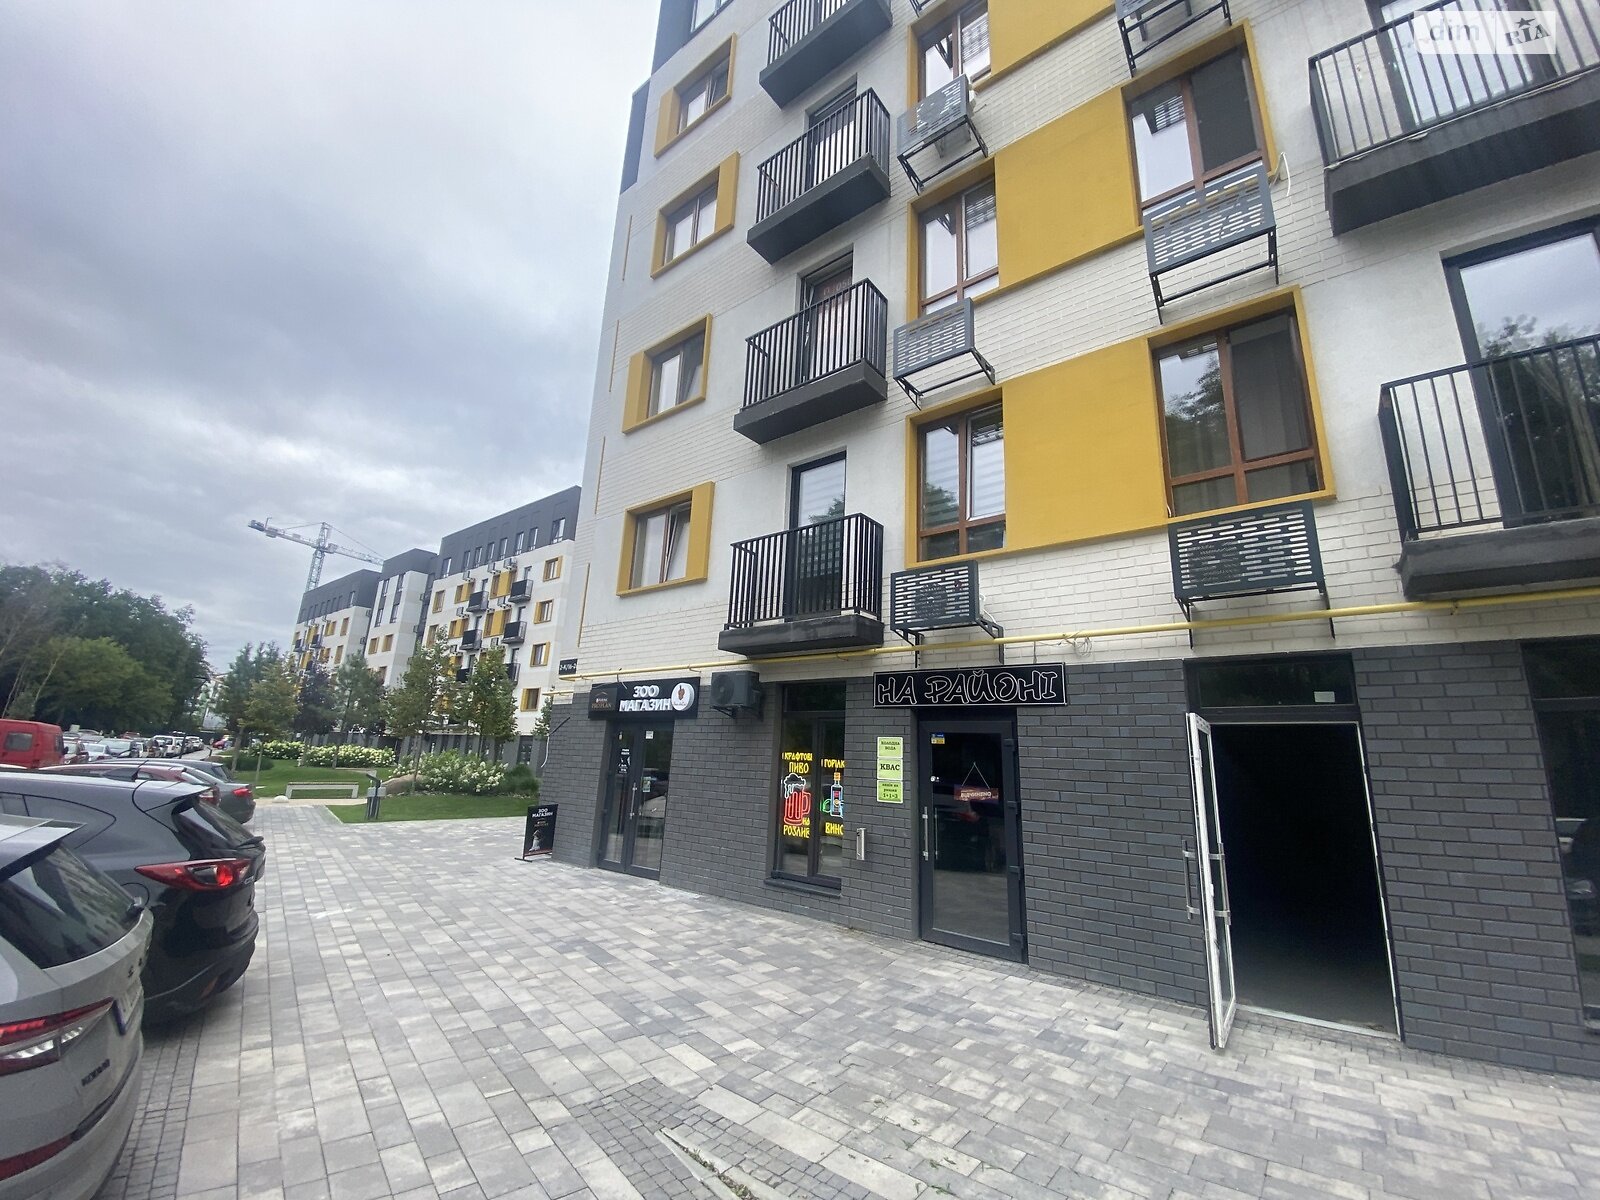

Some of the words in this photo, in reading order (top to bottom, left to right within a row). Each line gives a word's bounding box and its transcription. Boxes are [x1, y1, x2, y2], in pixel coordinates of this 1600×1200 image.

[633, 685, 660, 698] ЗОО
[877, 675, 918, 705] НА
[923, 669, 1058, 705] РАЙОНІ
[619, 698, 672, 712] МАГАЗИН
[789, 762, 809, 773] ПИВО
